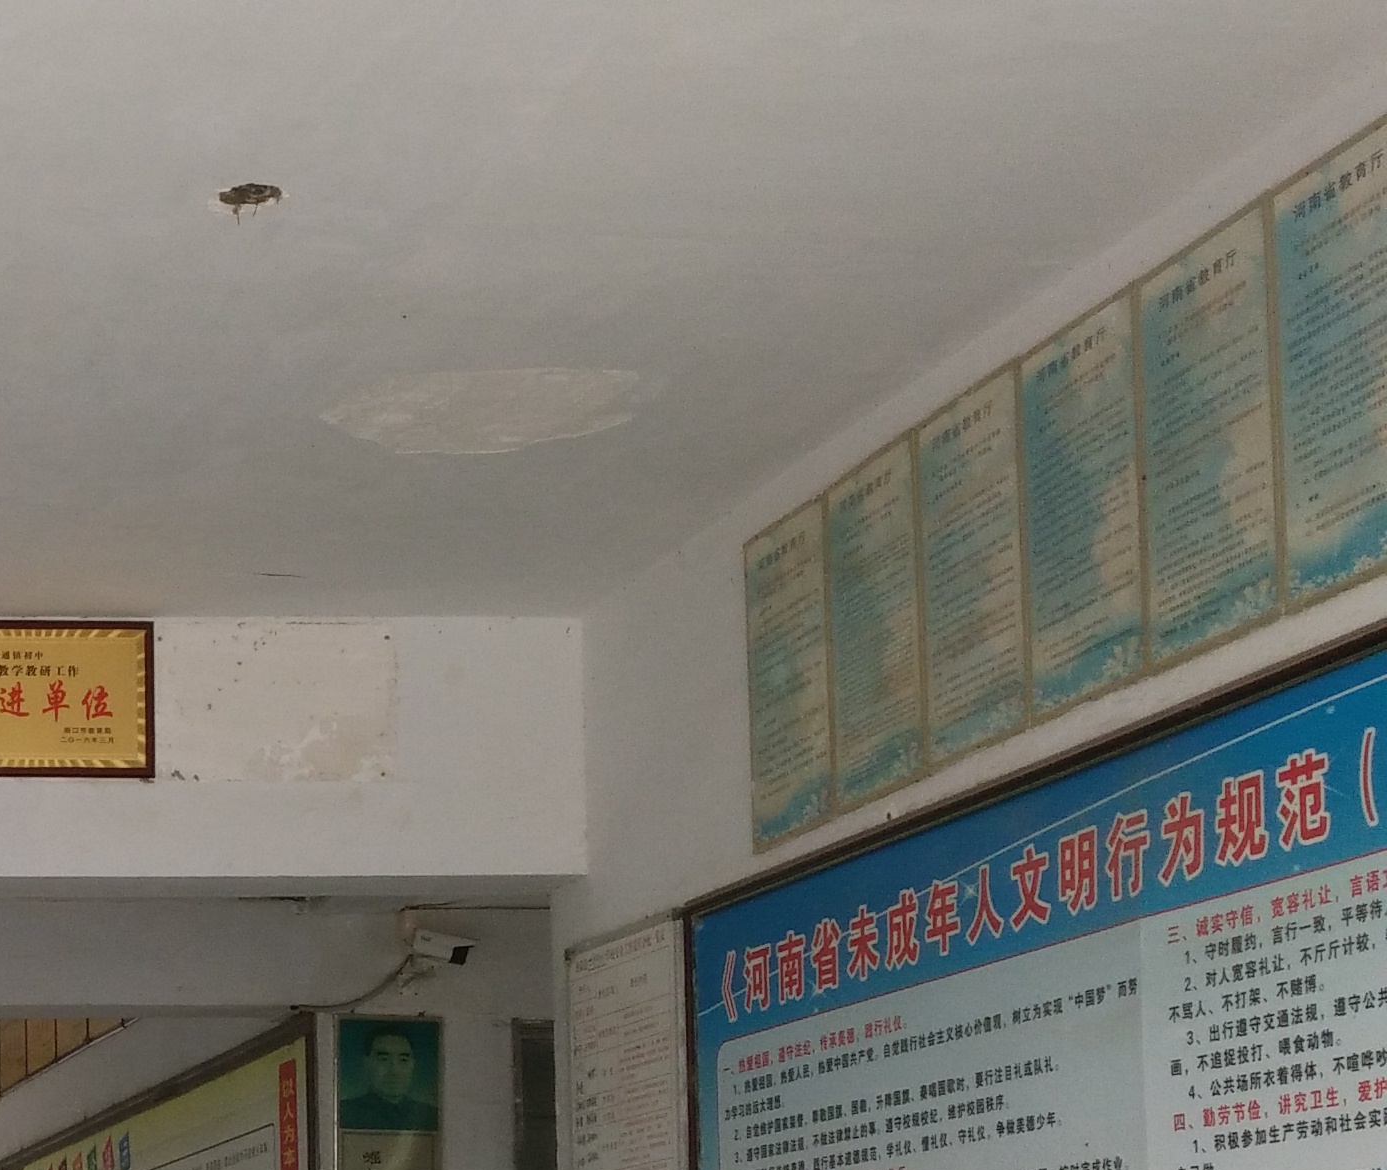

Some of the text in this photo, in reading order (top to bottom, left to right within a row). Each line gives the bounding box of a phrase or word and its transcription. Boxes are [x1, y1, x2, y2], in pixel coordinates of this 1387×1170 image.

[1184, 897, 1387, 968] 1、守时履约，言行一致，平等待
[1184, 927, 1387, 995] 2、对人宽容礼让，不斤斤计较，
[1168, 970, 1325, 1026] 不骂人、不打架、不赌博。
[280, 1078, 298, 1168] 以人为本
